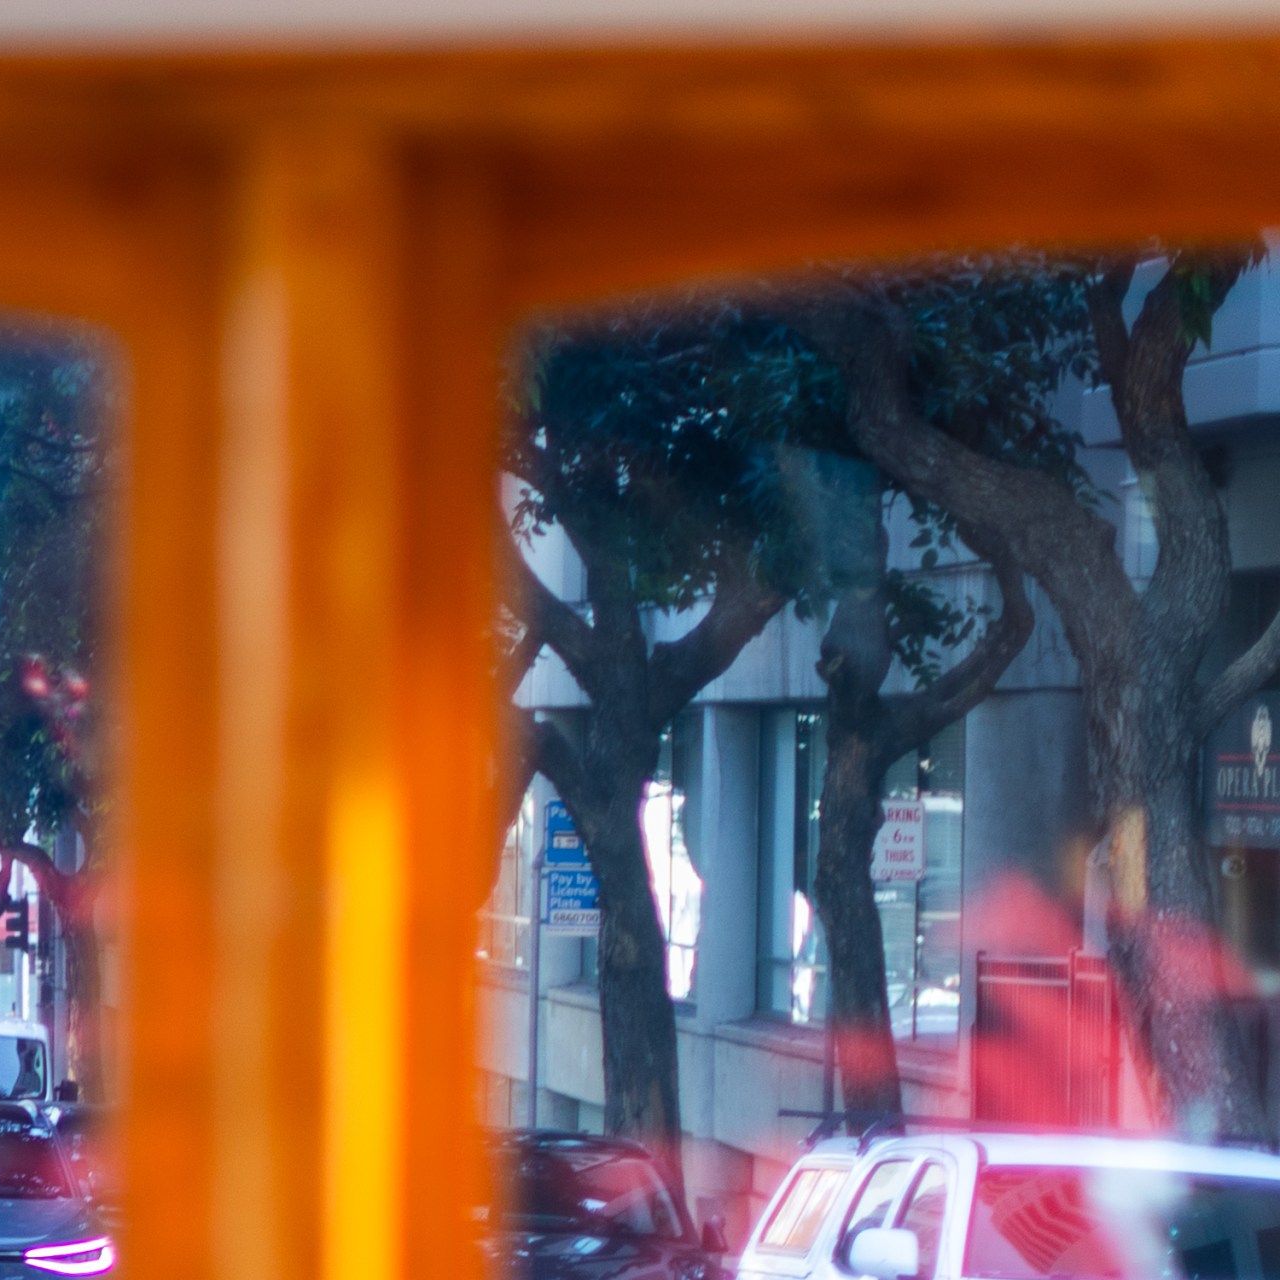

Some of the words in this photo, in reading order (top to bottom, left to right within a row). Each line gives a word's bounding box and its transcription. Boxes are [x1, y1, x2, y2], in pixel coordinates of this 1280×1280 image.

[887, 808, 920, 822] RKING
[893, 829, 901, 843] 6
[551, 872, 573, 889] Pay
[576, 872, 593, 888] by
[551, 885, 596, 896] License
[551, 897, 581, 908] Plate
